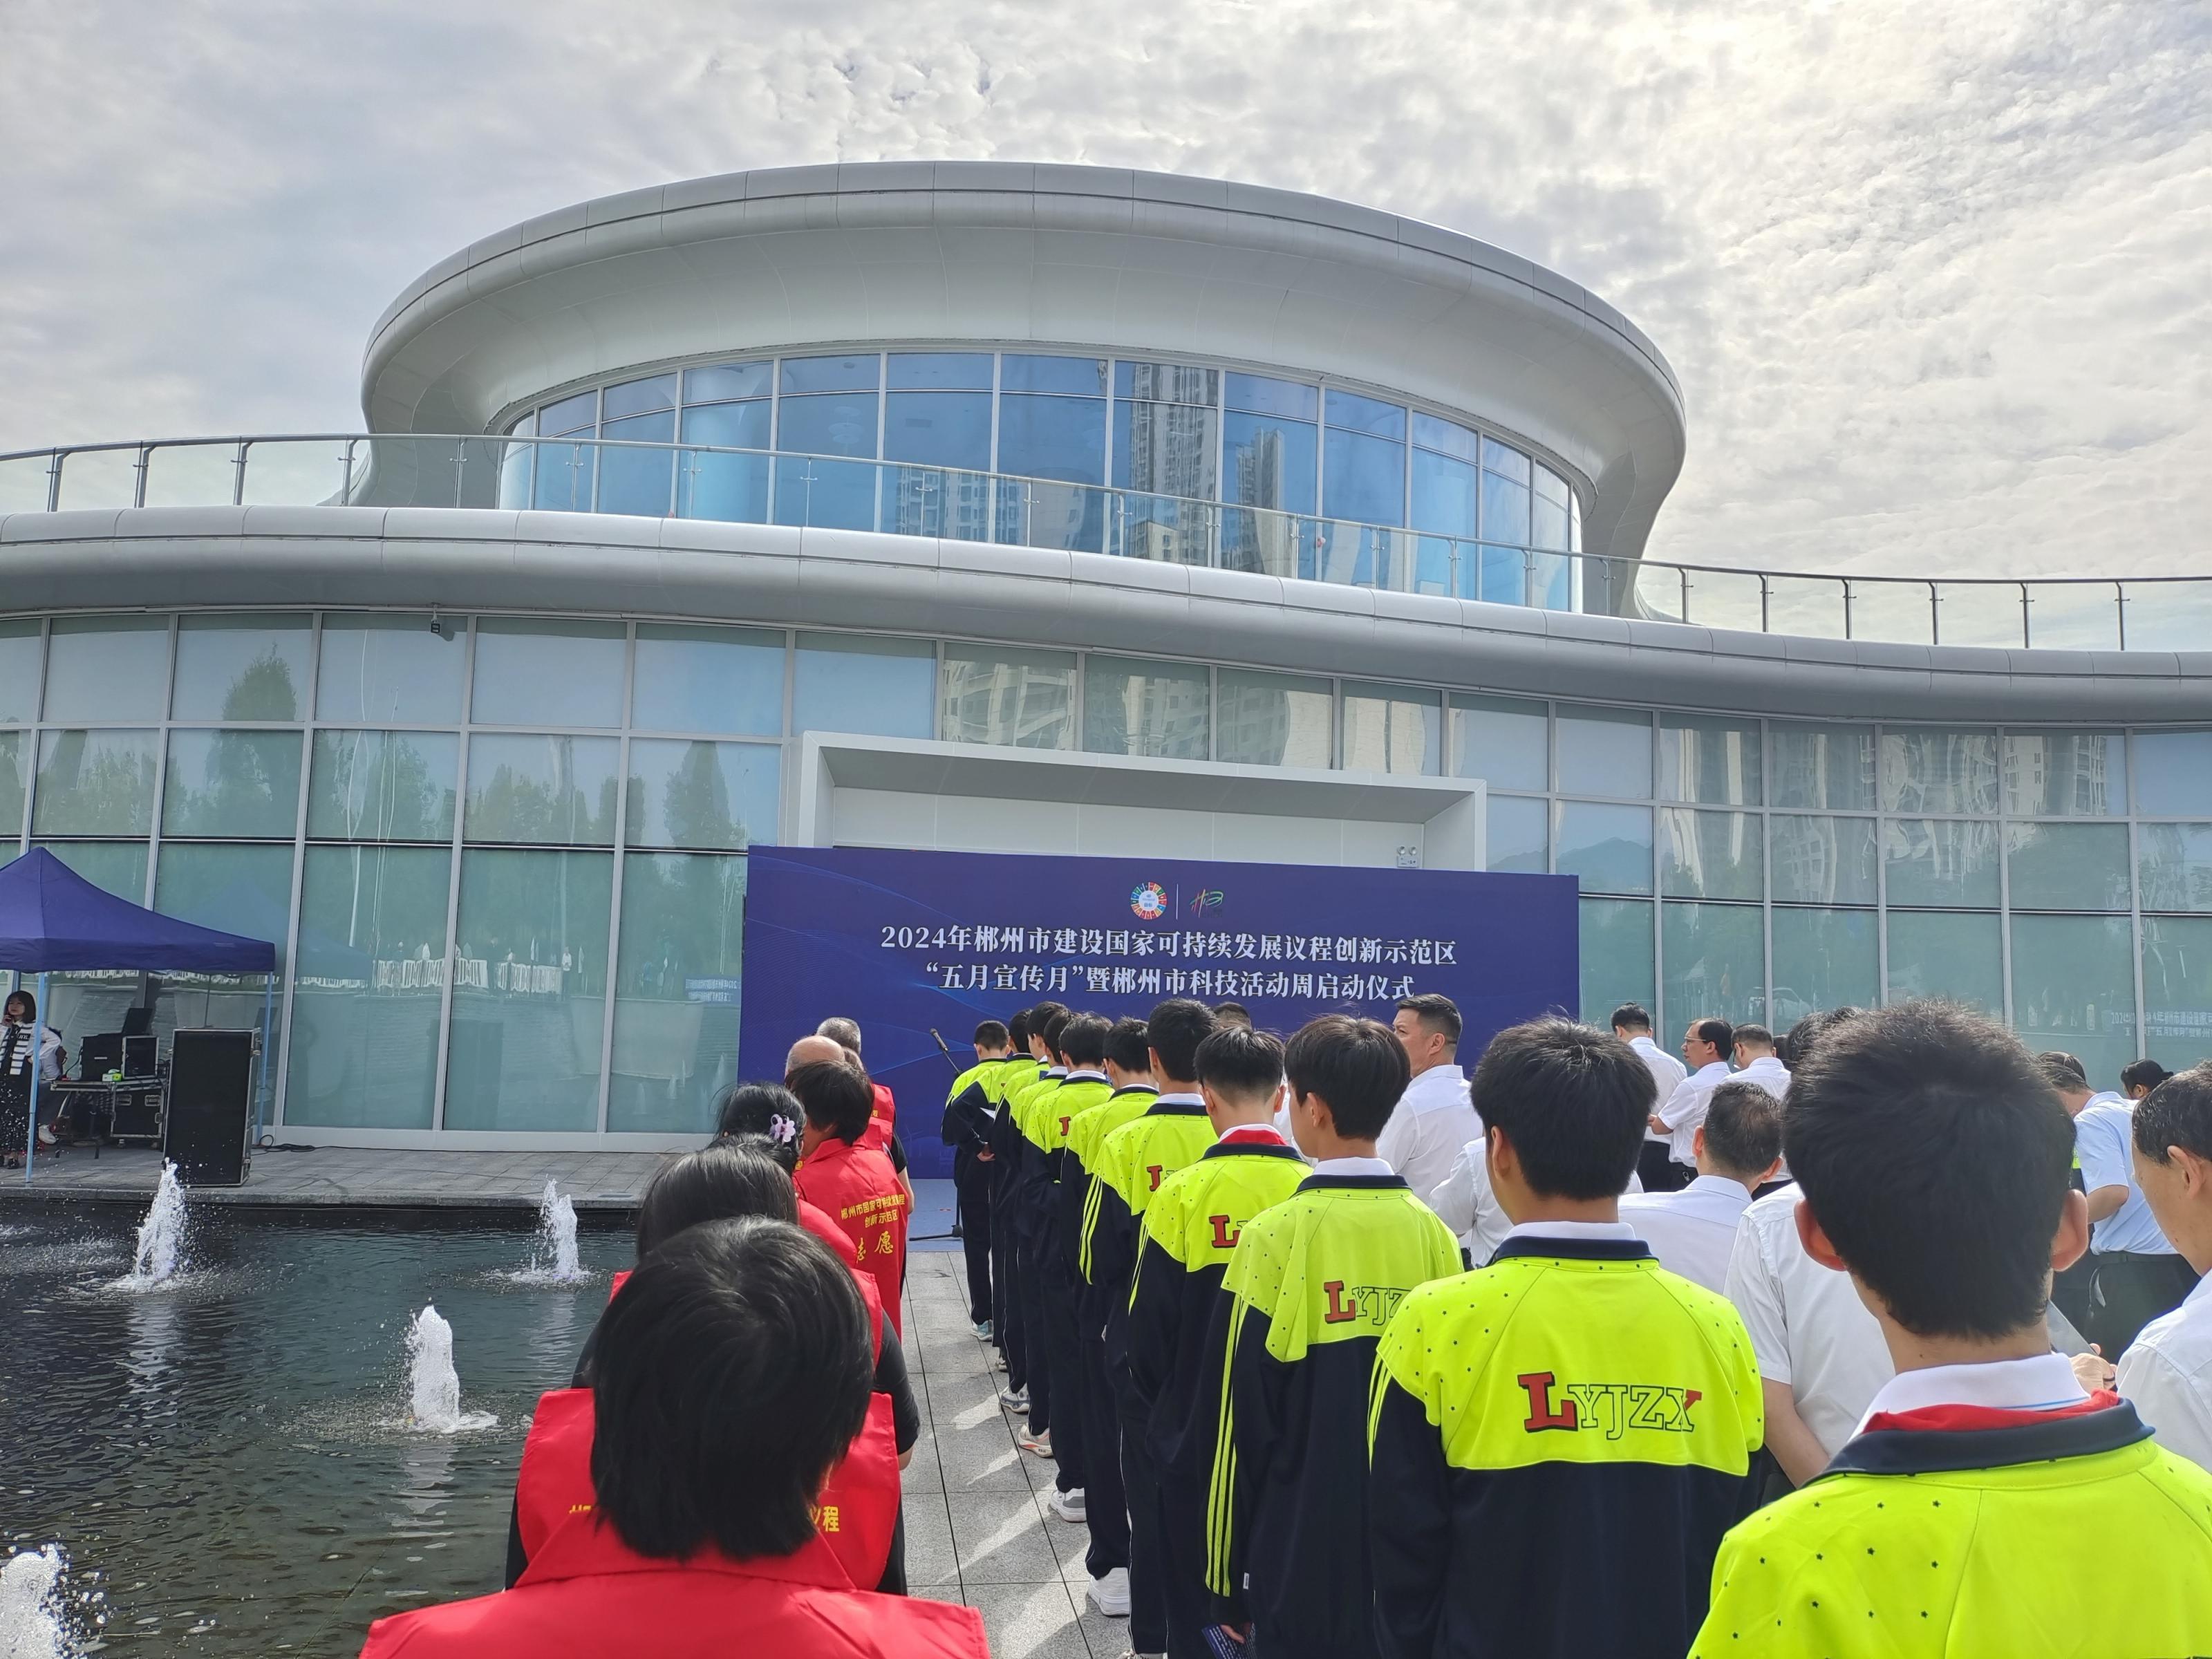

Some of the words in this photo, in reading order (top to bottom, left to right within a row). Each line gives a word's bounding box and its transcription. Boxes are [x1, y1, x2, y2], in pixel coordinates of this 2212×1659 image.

[881, 925, 1457, 965] 2024年郴州市建设国家可持续发展议程创新示范区
[1517, 1371, 1702, 1440] LYJZX
